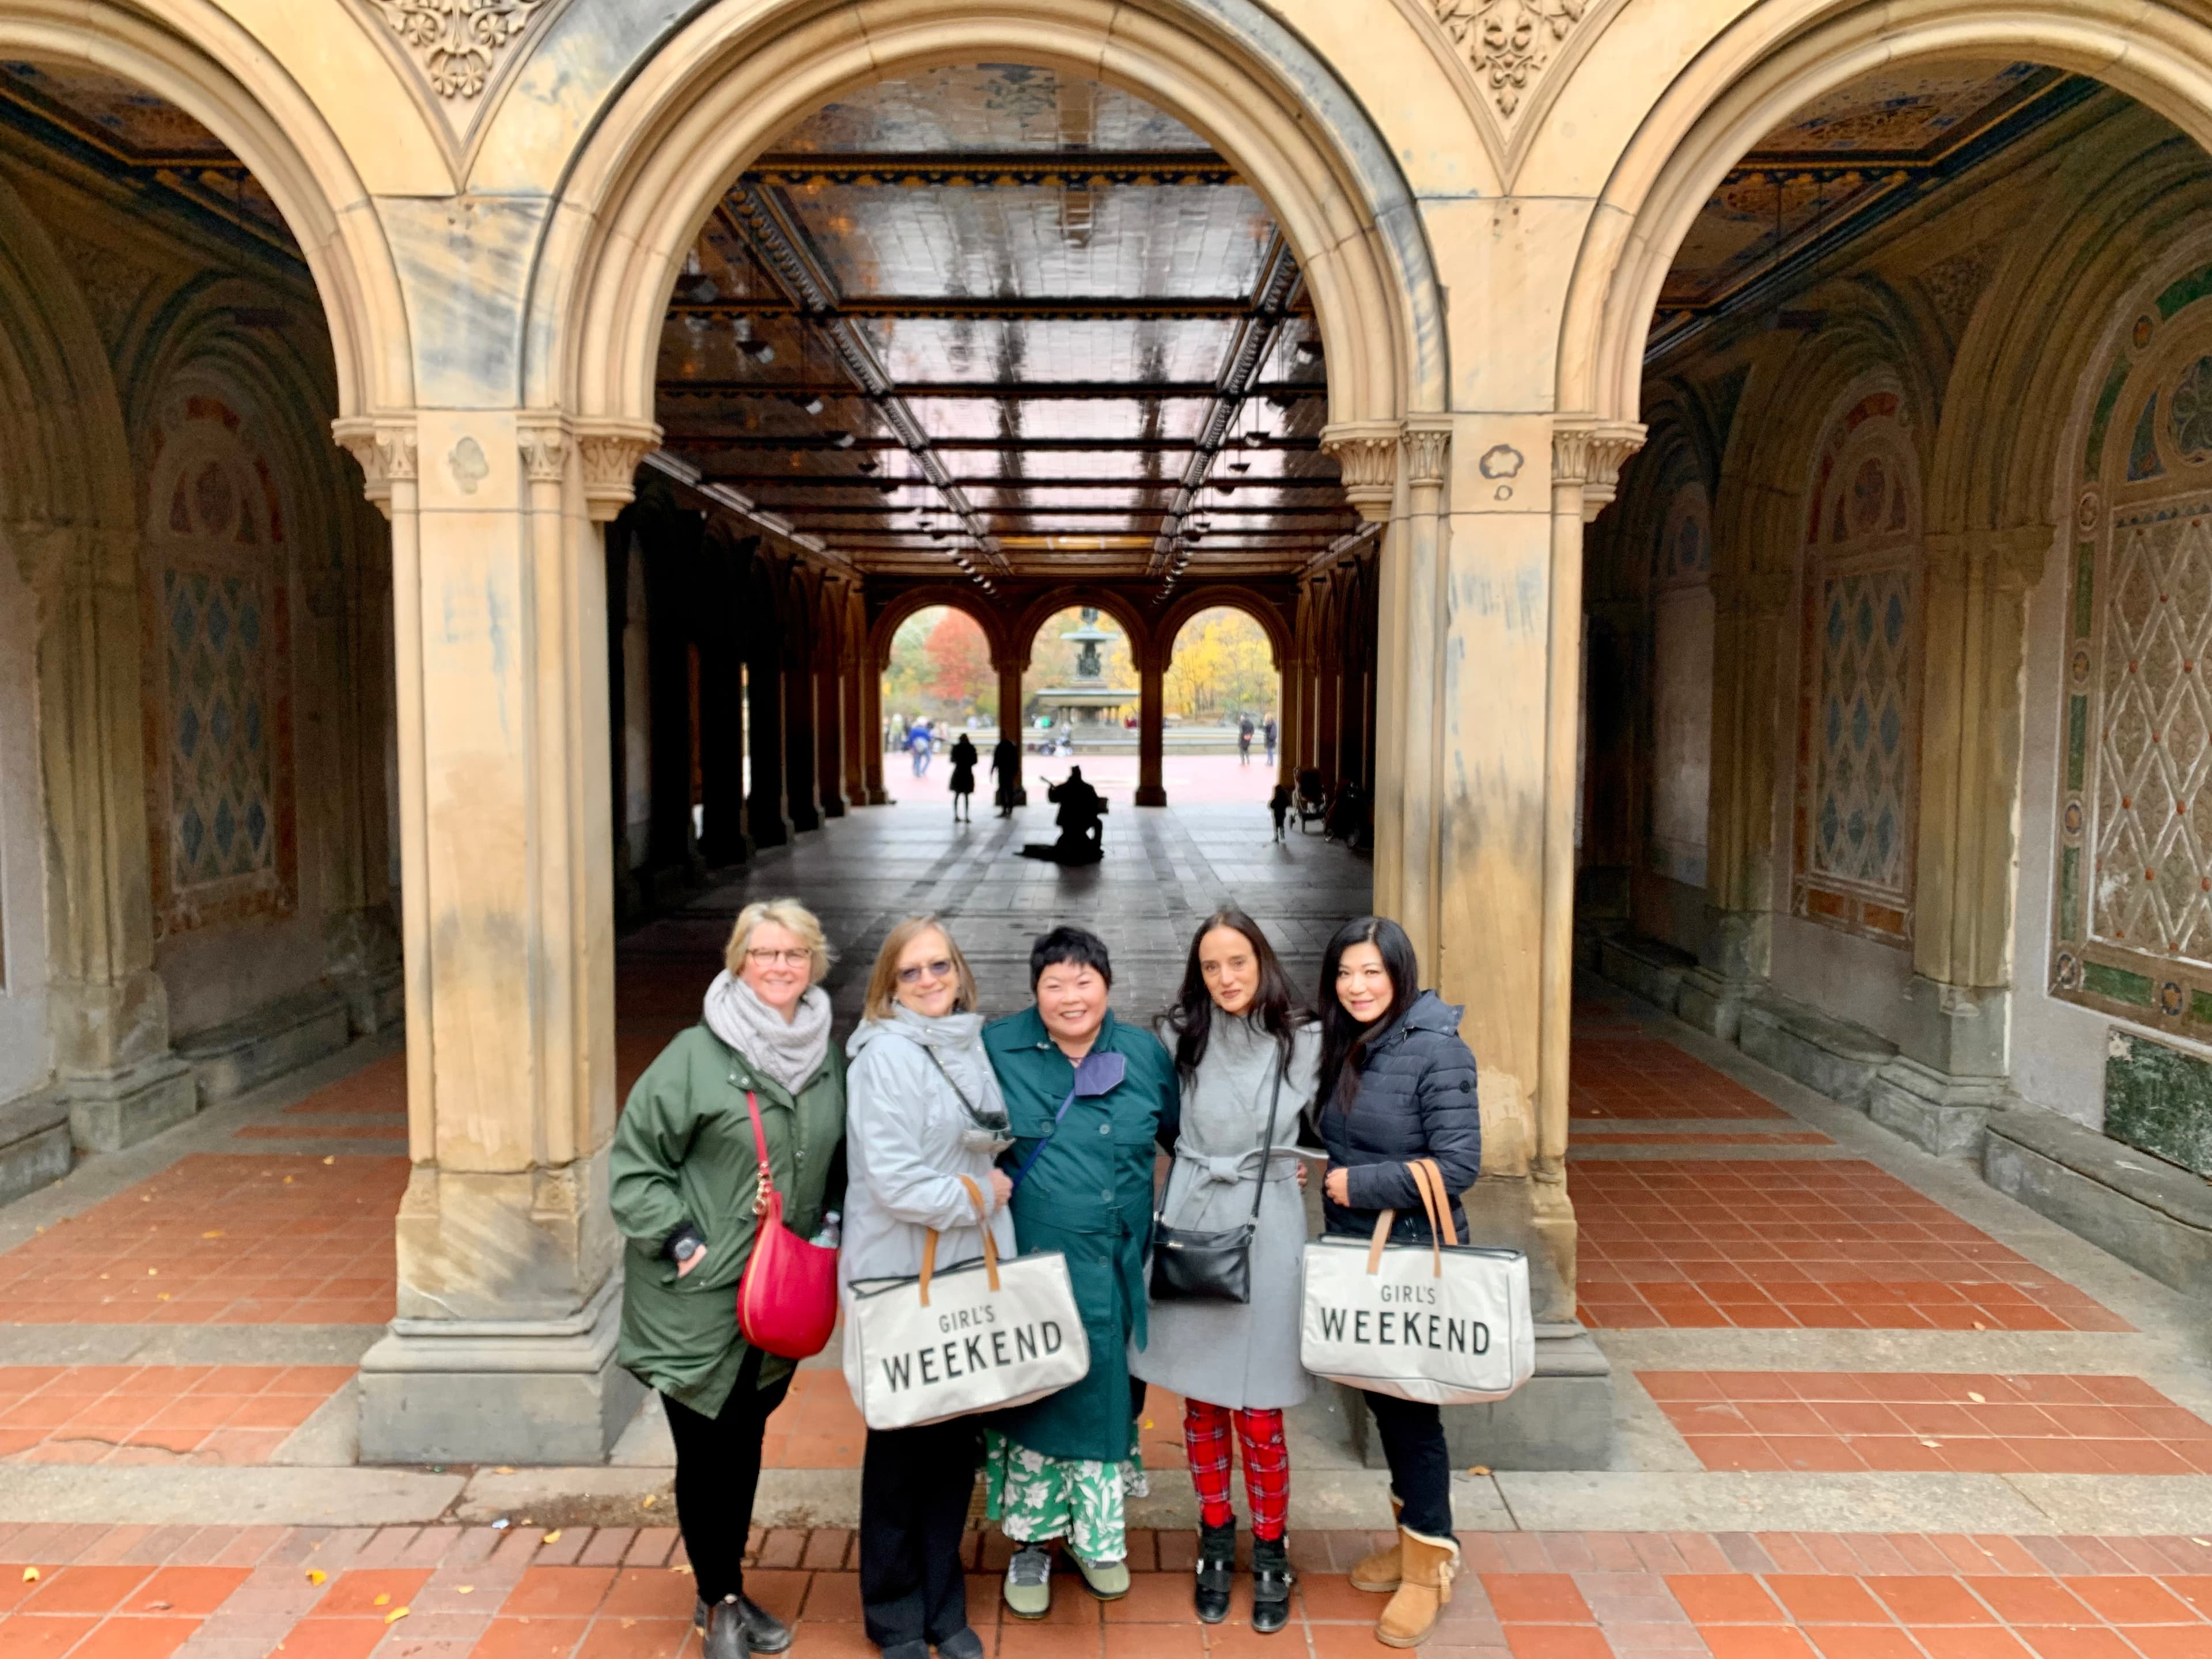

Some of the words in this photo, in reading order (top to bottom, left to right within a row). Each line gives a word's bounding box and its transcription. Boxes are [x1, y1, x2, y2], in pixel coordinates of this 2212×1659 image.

[1381, 1285, 1436, 1305] GIRL'S
[938, 1304, 997, 1333] GIRL'S
[1320, 1307, 1490, 1356] WEEKEND
[881, 1320, 1062, 1393] WEEKEND
